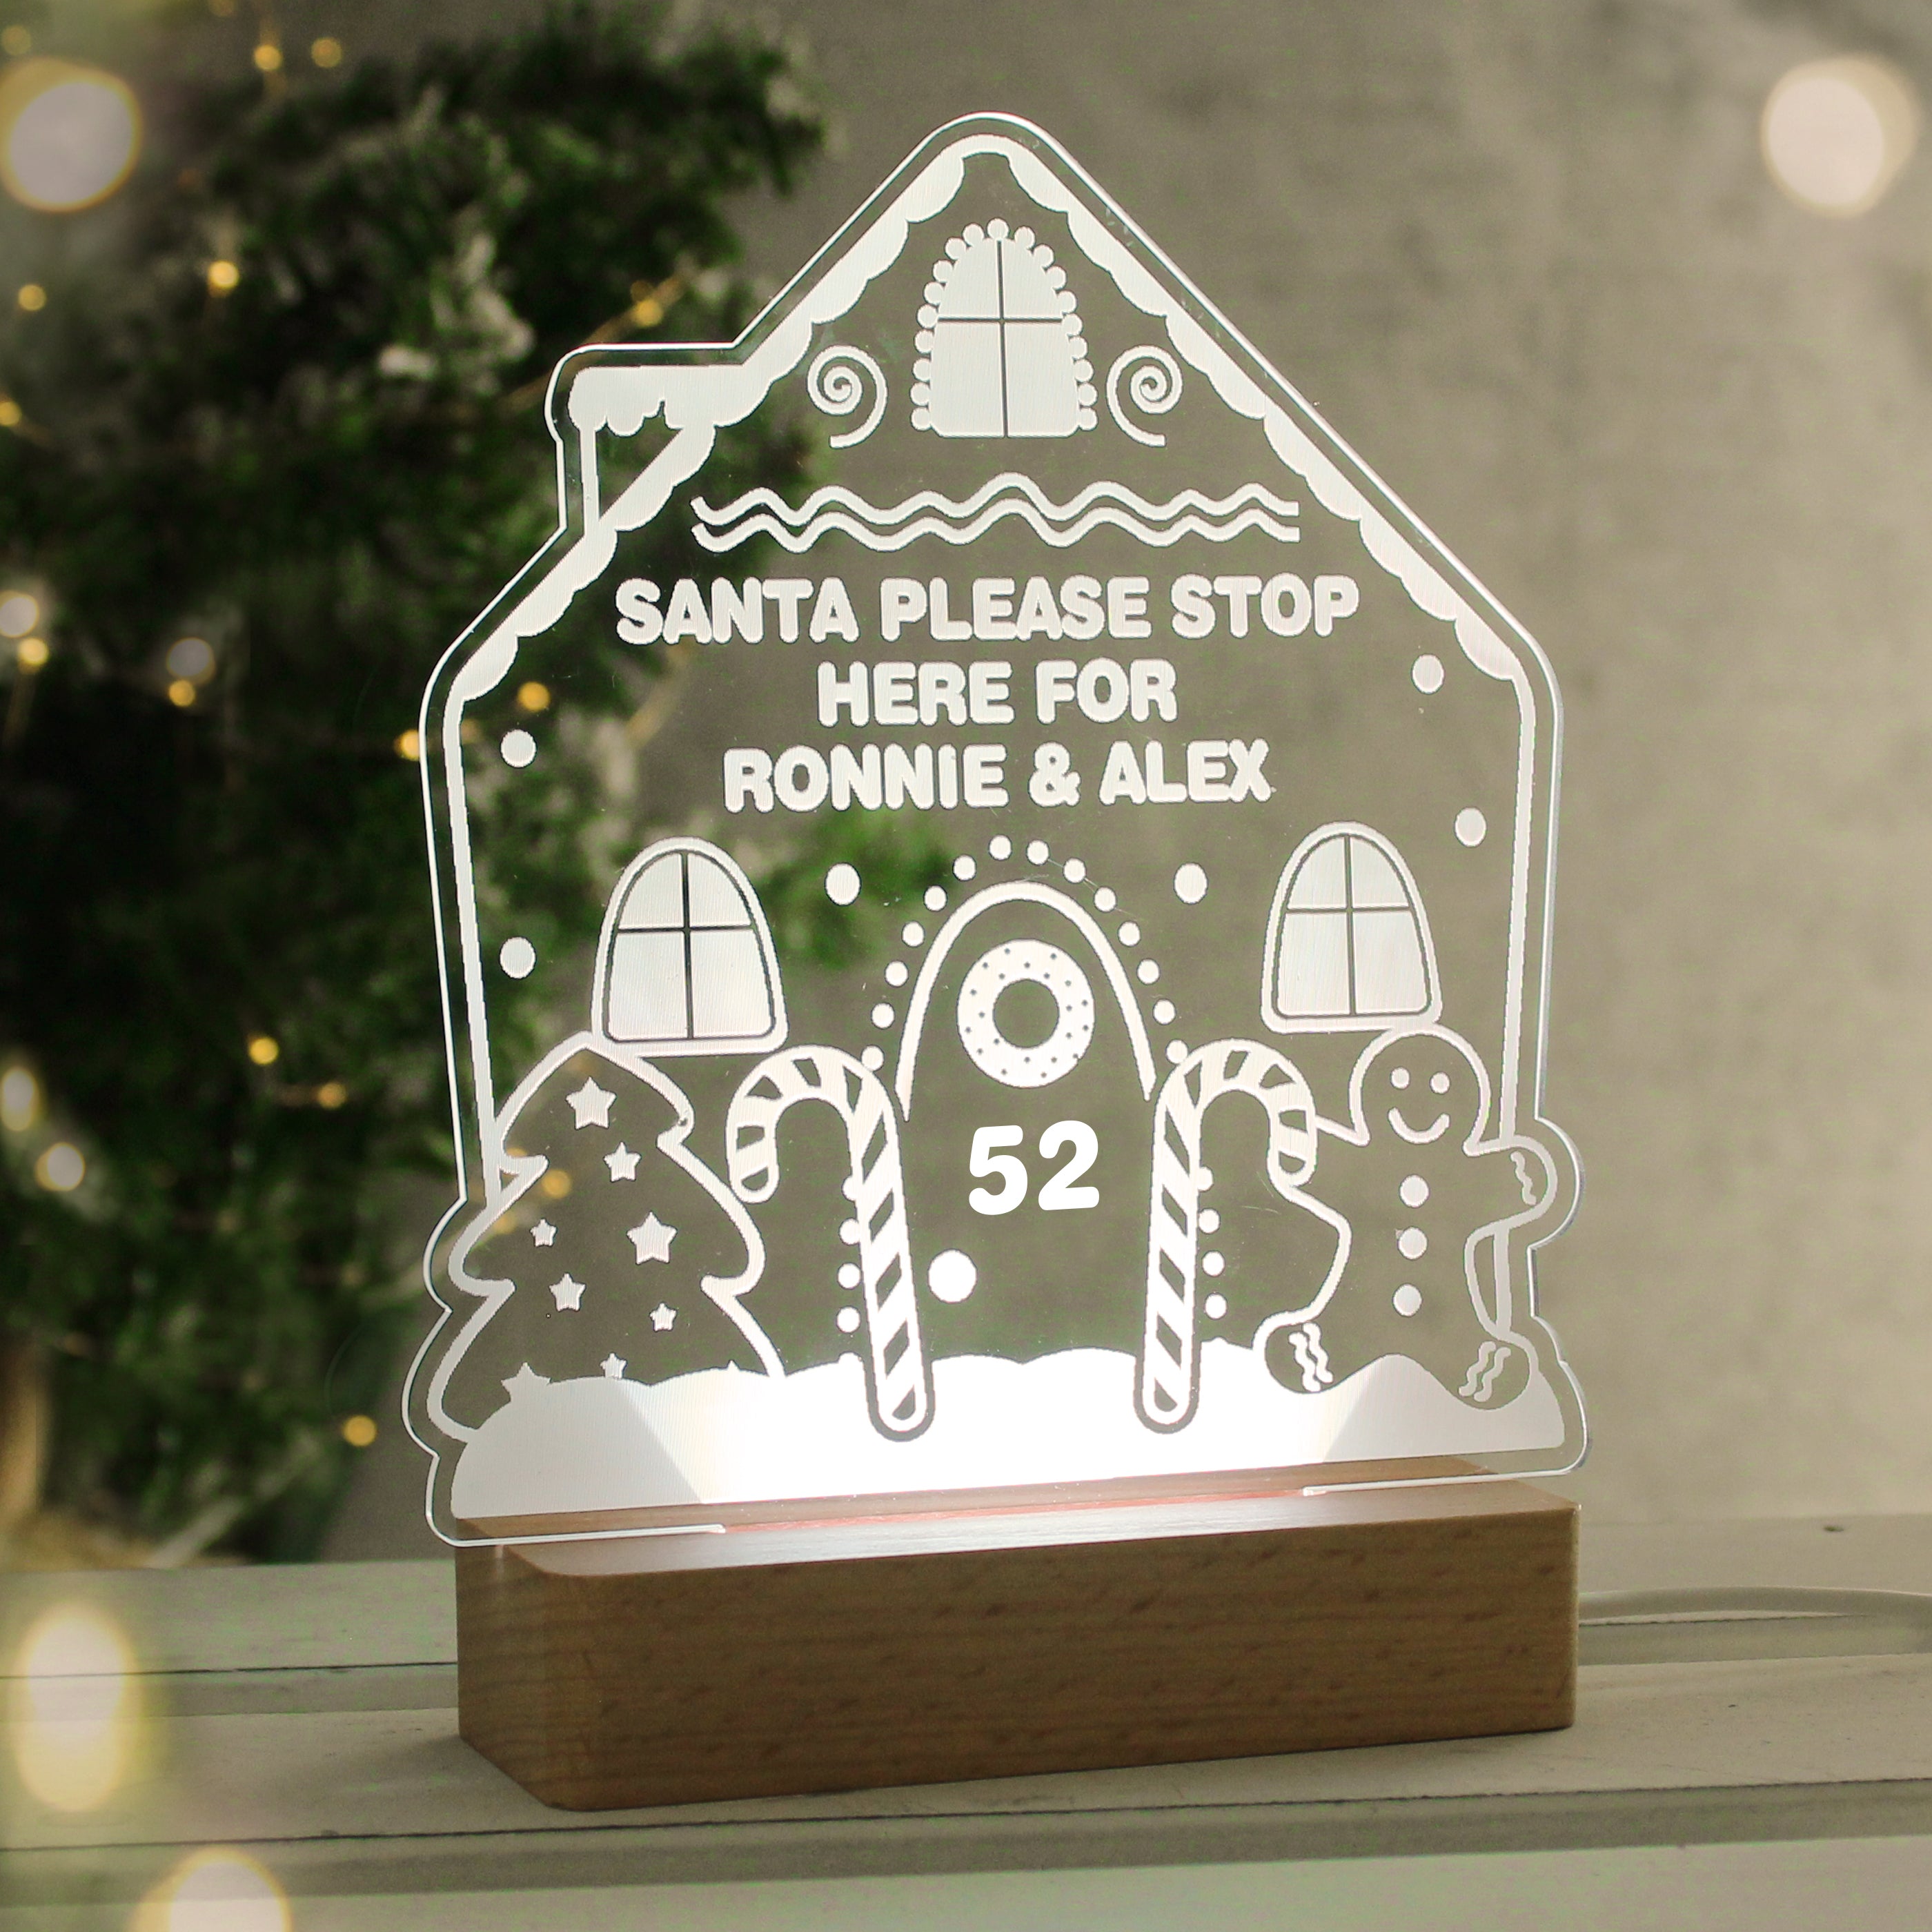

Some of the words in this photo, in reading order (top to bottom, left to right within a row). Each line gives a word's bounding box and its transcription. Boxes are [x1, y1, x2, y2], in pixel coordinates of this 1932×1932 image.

[615, 577, 859, 645] SANTA
[880, 575, 1152, 642] PLEASE
[1171, 573, 1359, 639] STOP
[818, 659, 1014, 727] HERE
[1036, 658, 1178, 724] FOR
[724, 744, 1008, 814] RONNIE
[1029, 742, 1080, 807] &
[1099, 739, 1272, 805] ALEX
[969, 1120, 1100, 1216] 52
